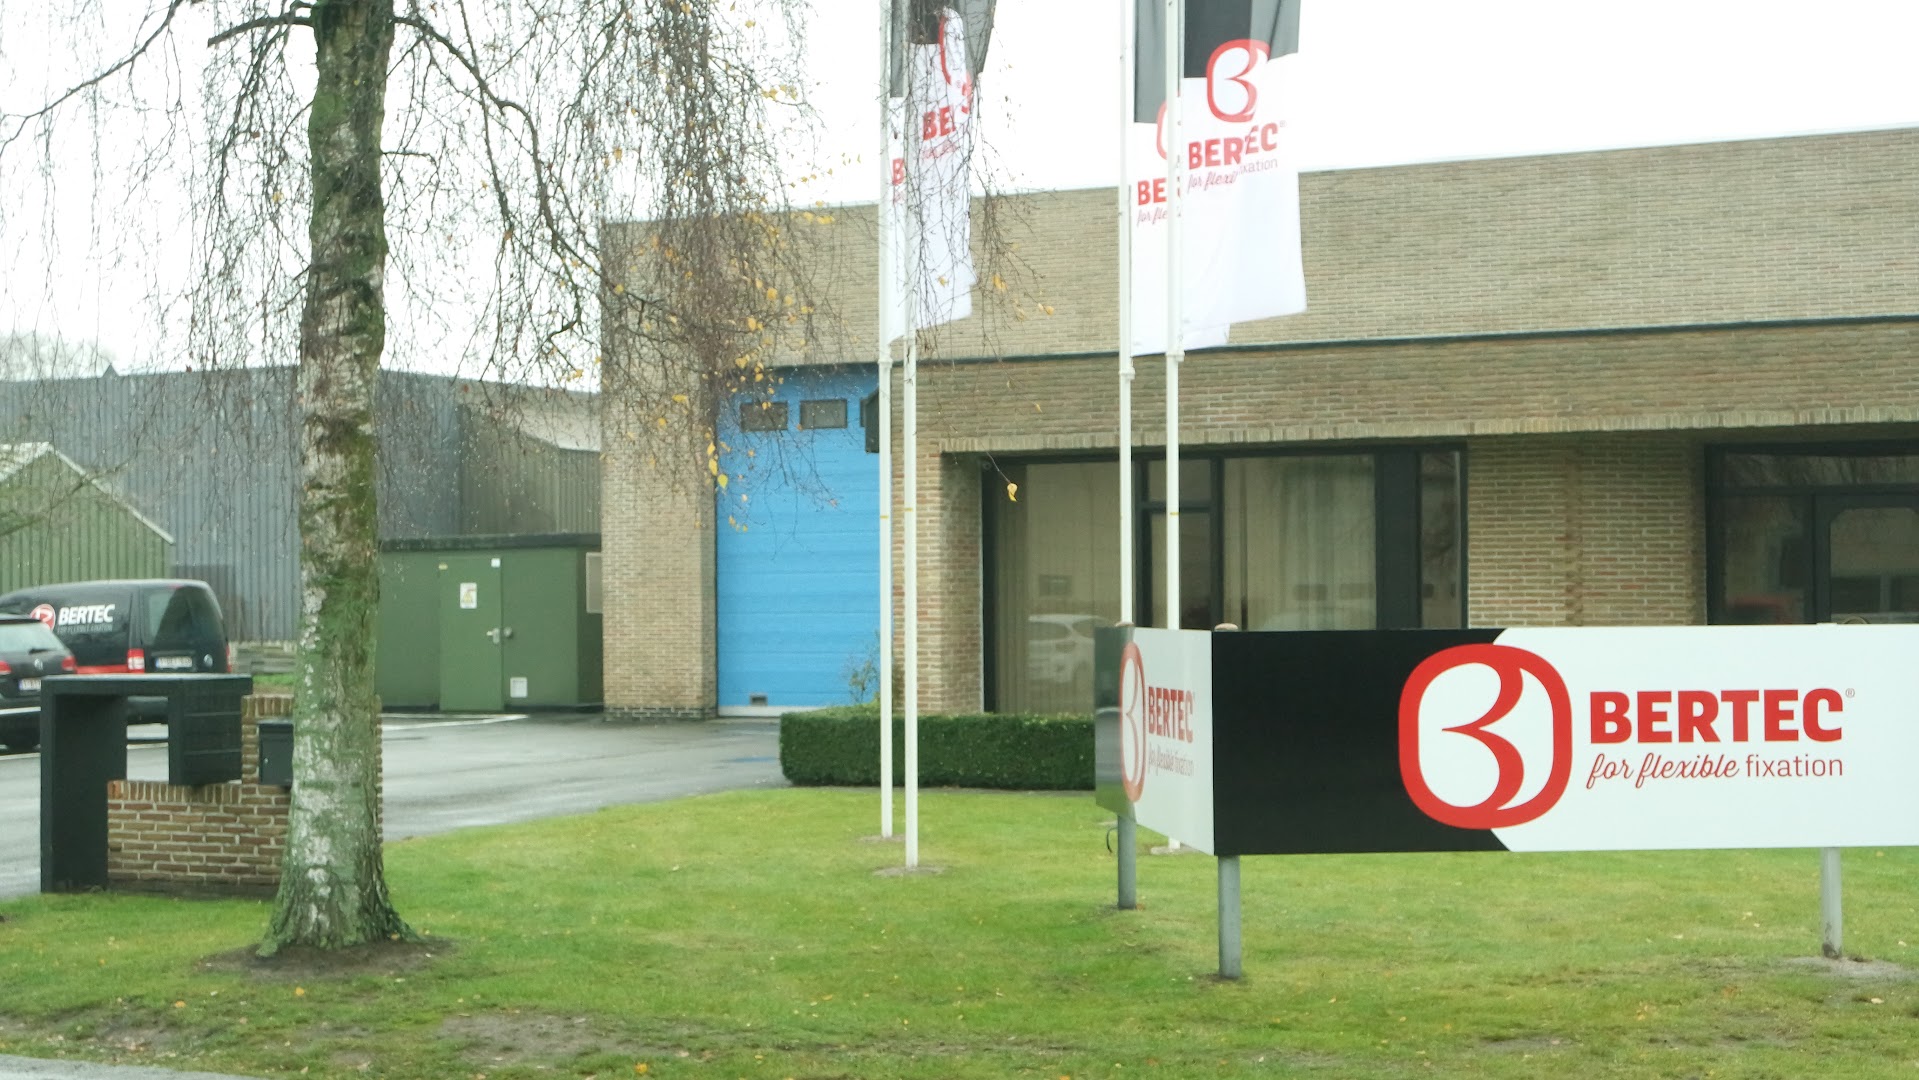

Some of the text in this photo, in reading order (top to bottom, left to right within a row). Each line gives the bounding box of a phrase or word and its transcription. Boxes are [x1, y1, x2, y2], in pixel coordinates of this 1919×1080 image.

[58, 603, 116, 626] BERTEC
[1148, 685, 1194, 744] BERTEC
[1586, 752, 1844, 790] for flexible fixation
